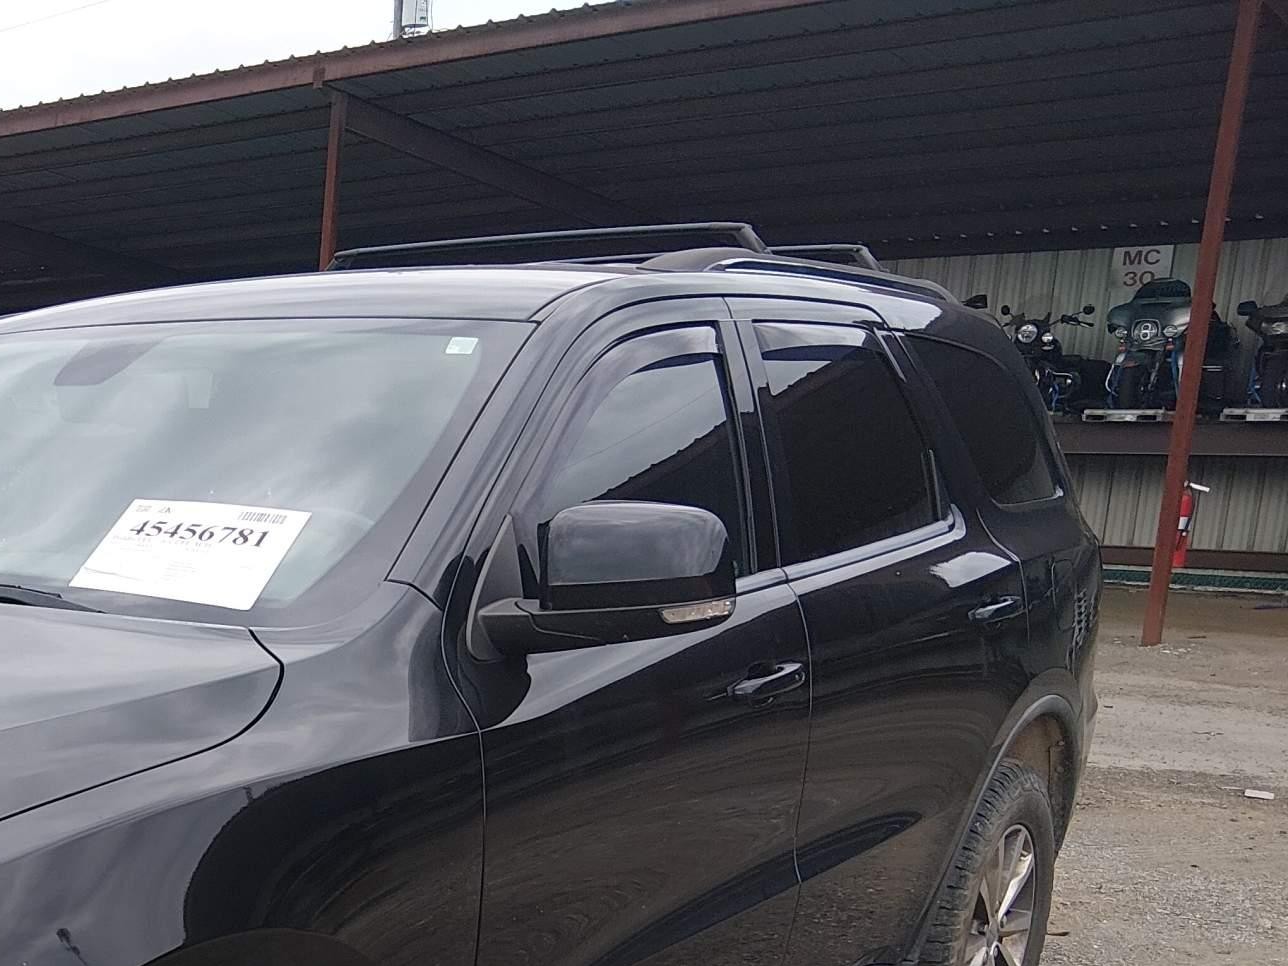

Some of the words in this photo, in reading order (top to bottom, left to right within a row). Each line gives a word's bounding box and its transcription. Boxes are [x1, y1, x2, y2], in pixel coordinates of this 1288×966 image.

[1122, 249, 1161, 266] MC
[1122, 270, 1156, 287] 30
[129, 520, 270, 547] 45456781
